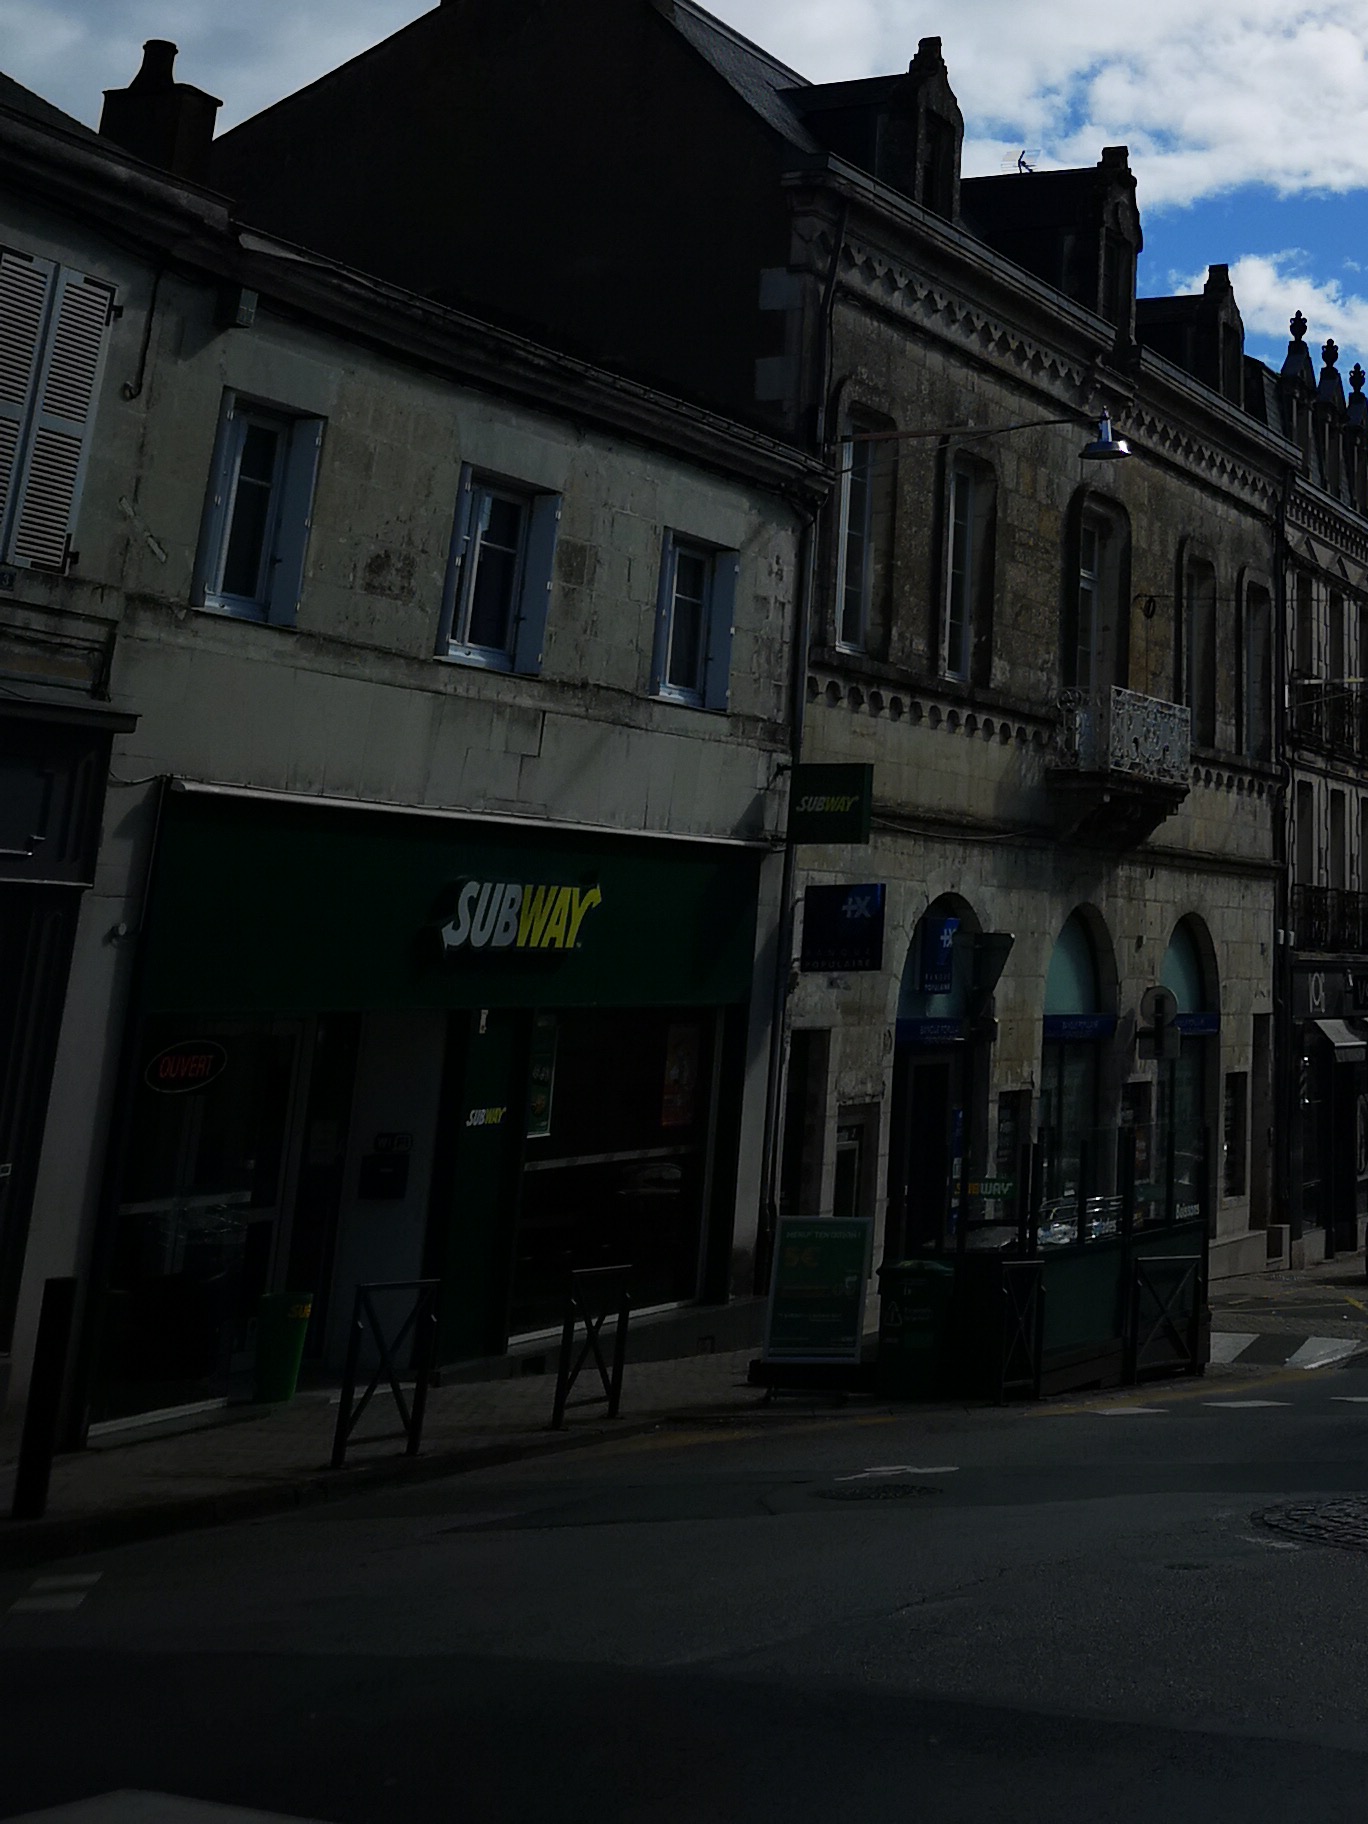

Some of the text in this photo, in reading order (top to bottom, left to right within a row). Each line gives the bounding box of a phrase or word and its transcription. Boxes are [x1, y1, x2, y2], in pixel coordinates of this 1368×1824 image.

[796, 795, 860, 813] SUBWAY
[441, 880, 602, 951] SUBWAY
[158, 1054, 216, 1079] OUVERT
[465, 1107, 507, 1128] SUBWAY
